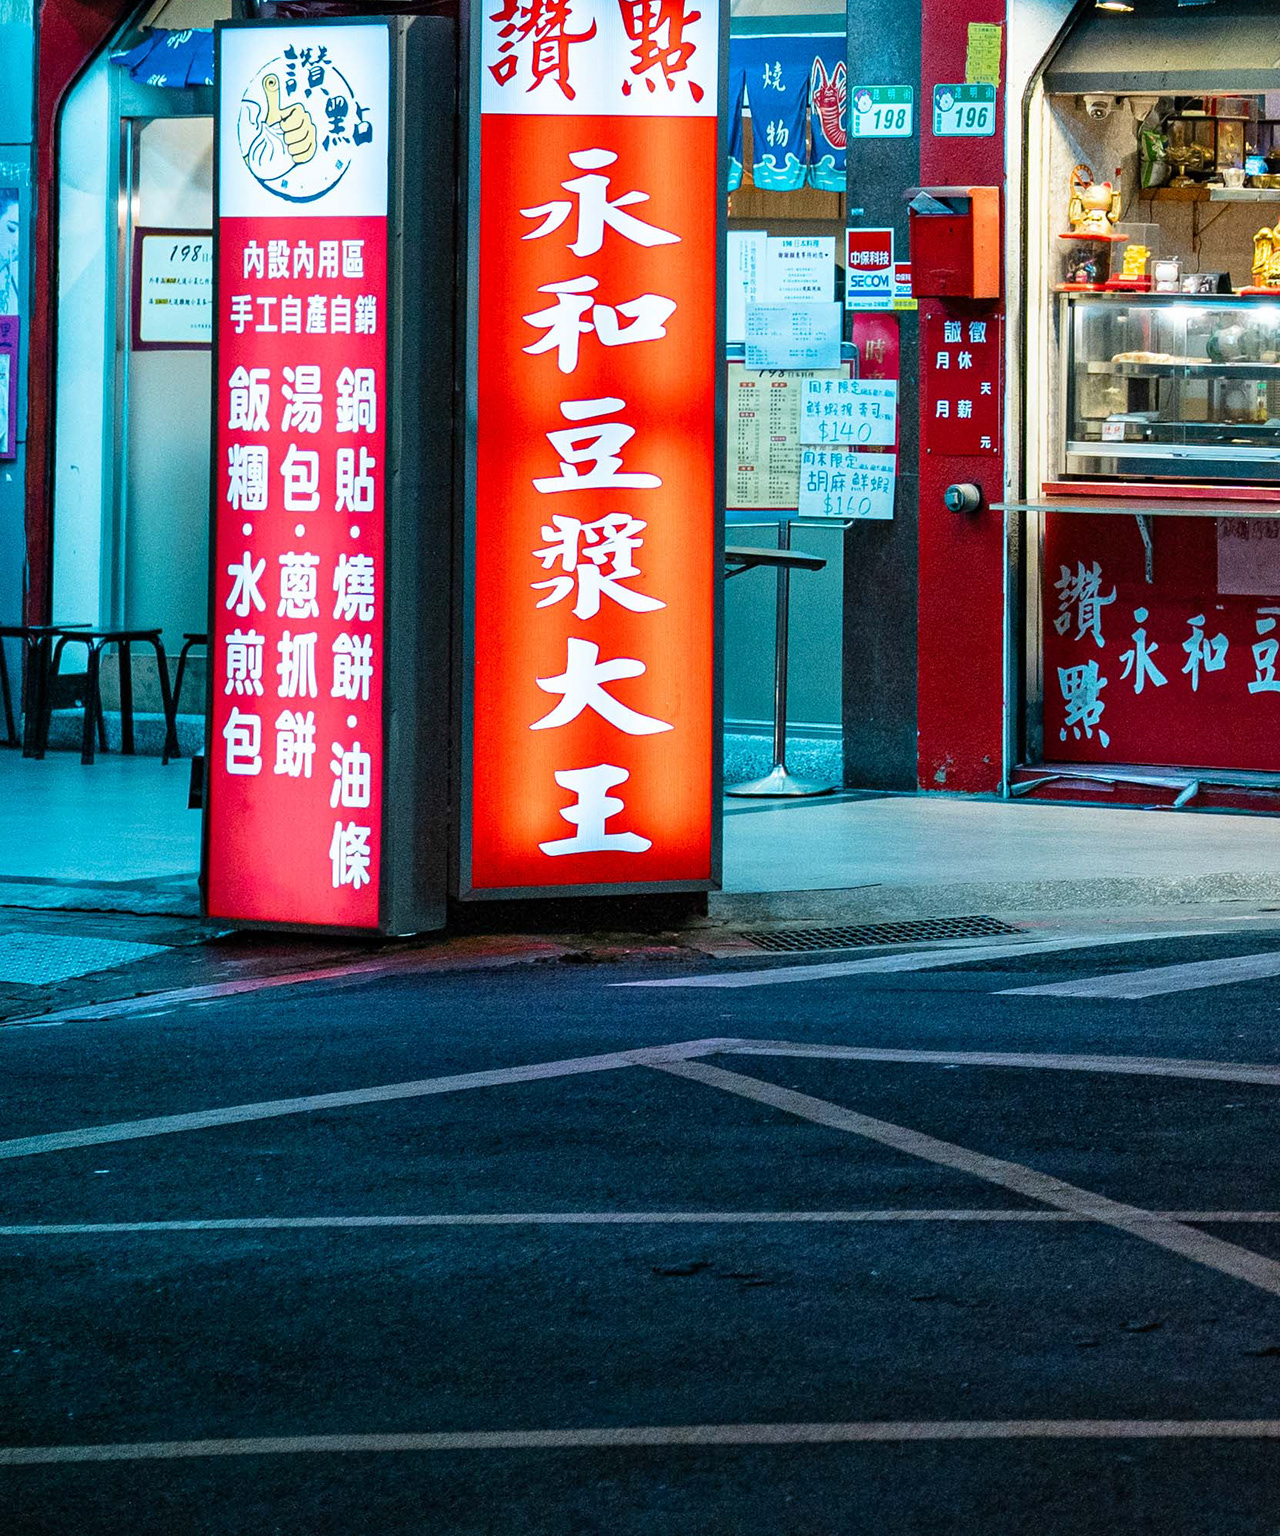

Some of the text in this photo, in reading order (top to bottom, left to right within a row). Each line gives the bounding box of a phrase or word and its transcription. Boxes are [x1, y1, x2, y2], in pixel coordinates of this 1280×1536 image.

[762, 61, 789, 147] 燒物
[874, 109, 906, 129] 198
[955, 107, 988, 128] 196
[170, 245, 202, 262] 198
[243, 240, 365, 279] 內設內用區
[851, 251, 889, 265] 中保科技
[851, 275, 889, 287] SECOM
[230, 295, 377, 334] 手工自產自銷
[944, 321, 987, 343] 誠徵
[936, 351, 973, 370] 月休
[980, 382, 991, 395] 天
[936, 400, 973, 419] 月薪
[819, 420, 872, 443] $140
[980, 436, 991, 449] 元
[807, 470, 889, 494] 胡麻鮮蝦
[519, 149, 683, 855] 永和豆漿大王
[823, 493, 872, 516] $160
[1054, 561, 1117, 748] 讚點
